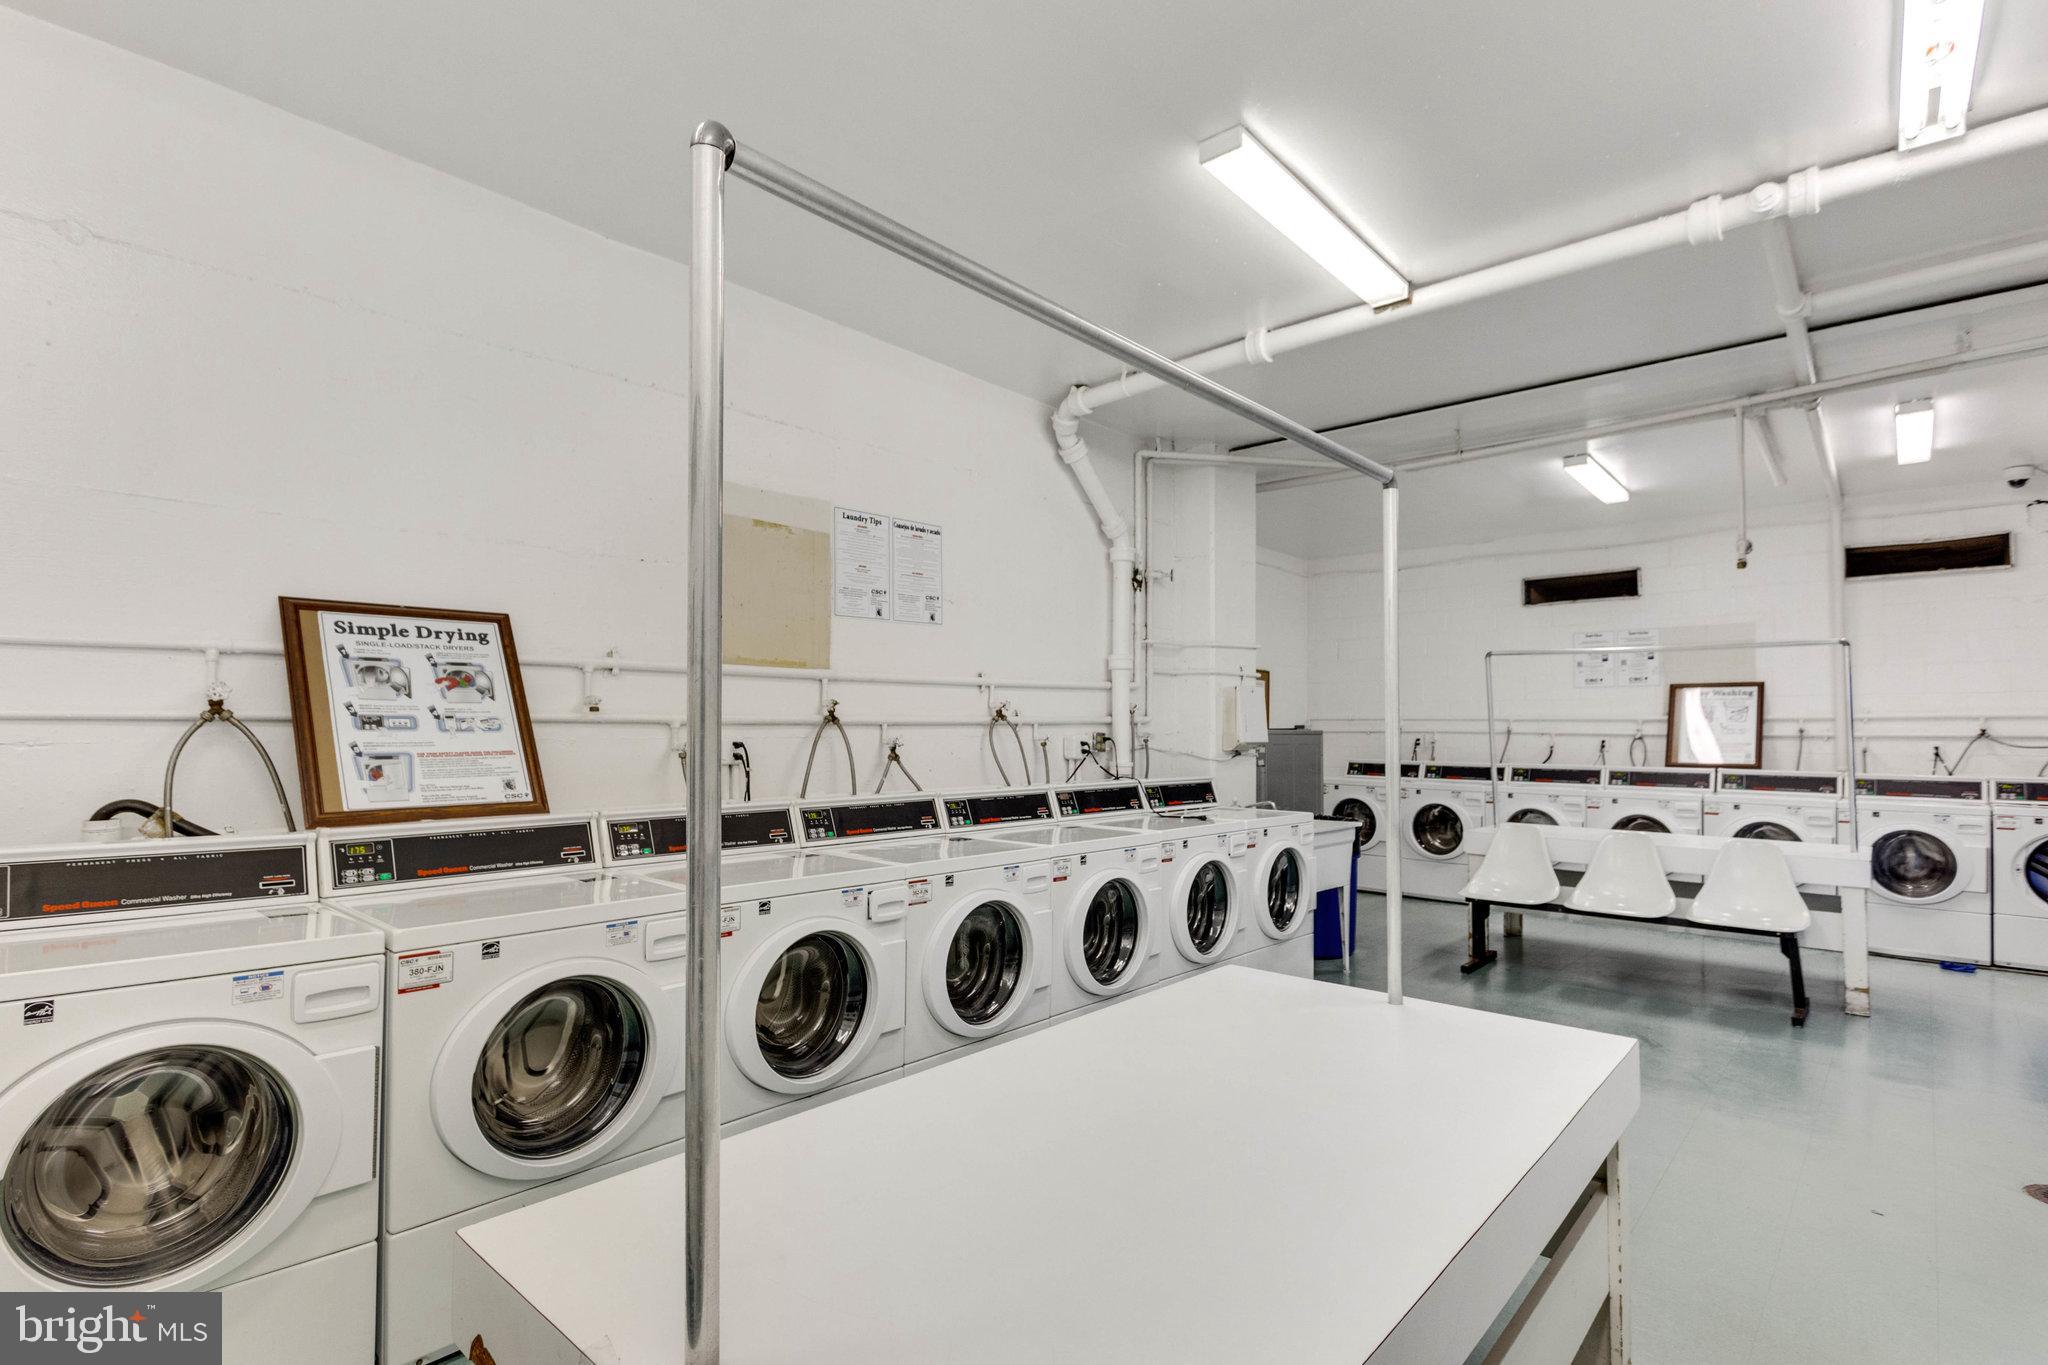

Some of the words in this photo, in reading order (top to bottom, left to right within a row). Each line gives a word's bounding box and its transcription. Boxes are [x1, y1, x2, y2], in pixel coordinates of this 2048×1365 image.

[842, 512, 868, 524] Laundry
[869, 516, 882, 526] Tips
[333, 619, 410, 641] Simple
[415, 625, 490, 645] Drying
[355, 640, 441, 651] SINGLE-LOAD/STACK
[442, 644, 475, 652] DRYERS
[416, 867, 443, 878] Speed
[468, 863, 497, 872] Commercial
[42, 900, 81, 914] Speed
[81, 899, 118, 909] Queen
[120, 896, 161, 906] Commercial
[161, 894, 188, 902] Washer
[408, 964, 445, 977] 380-FJN
